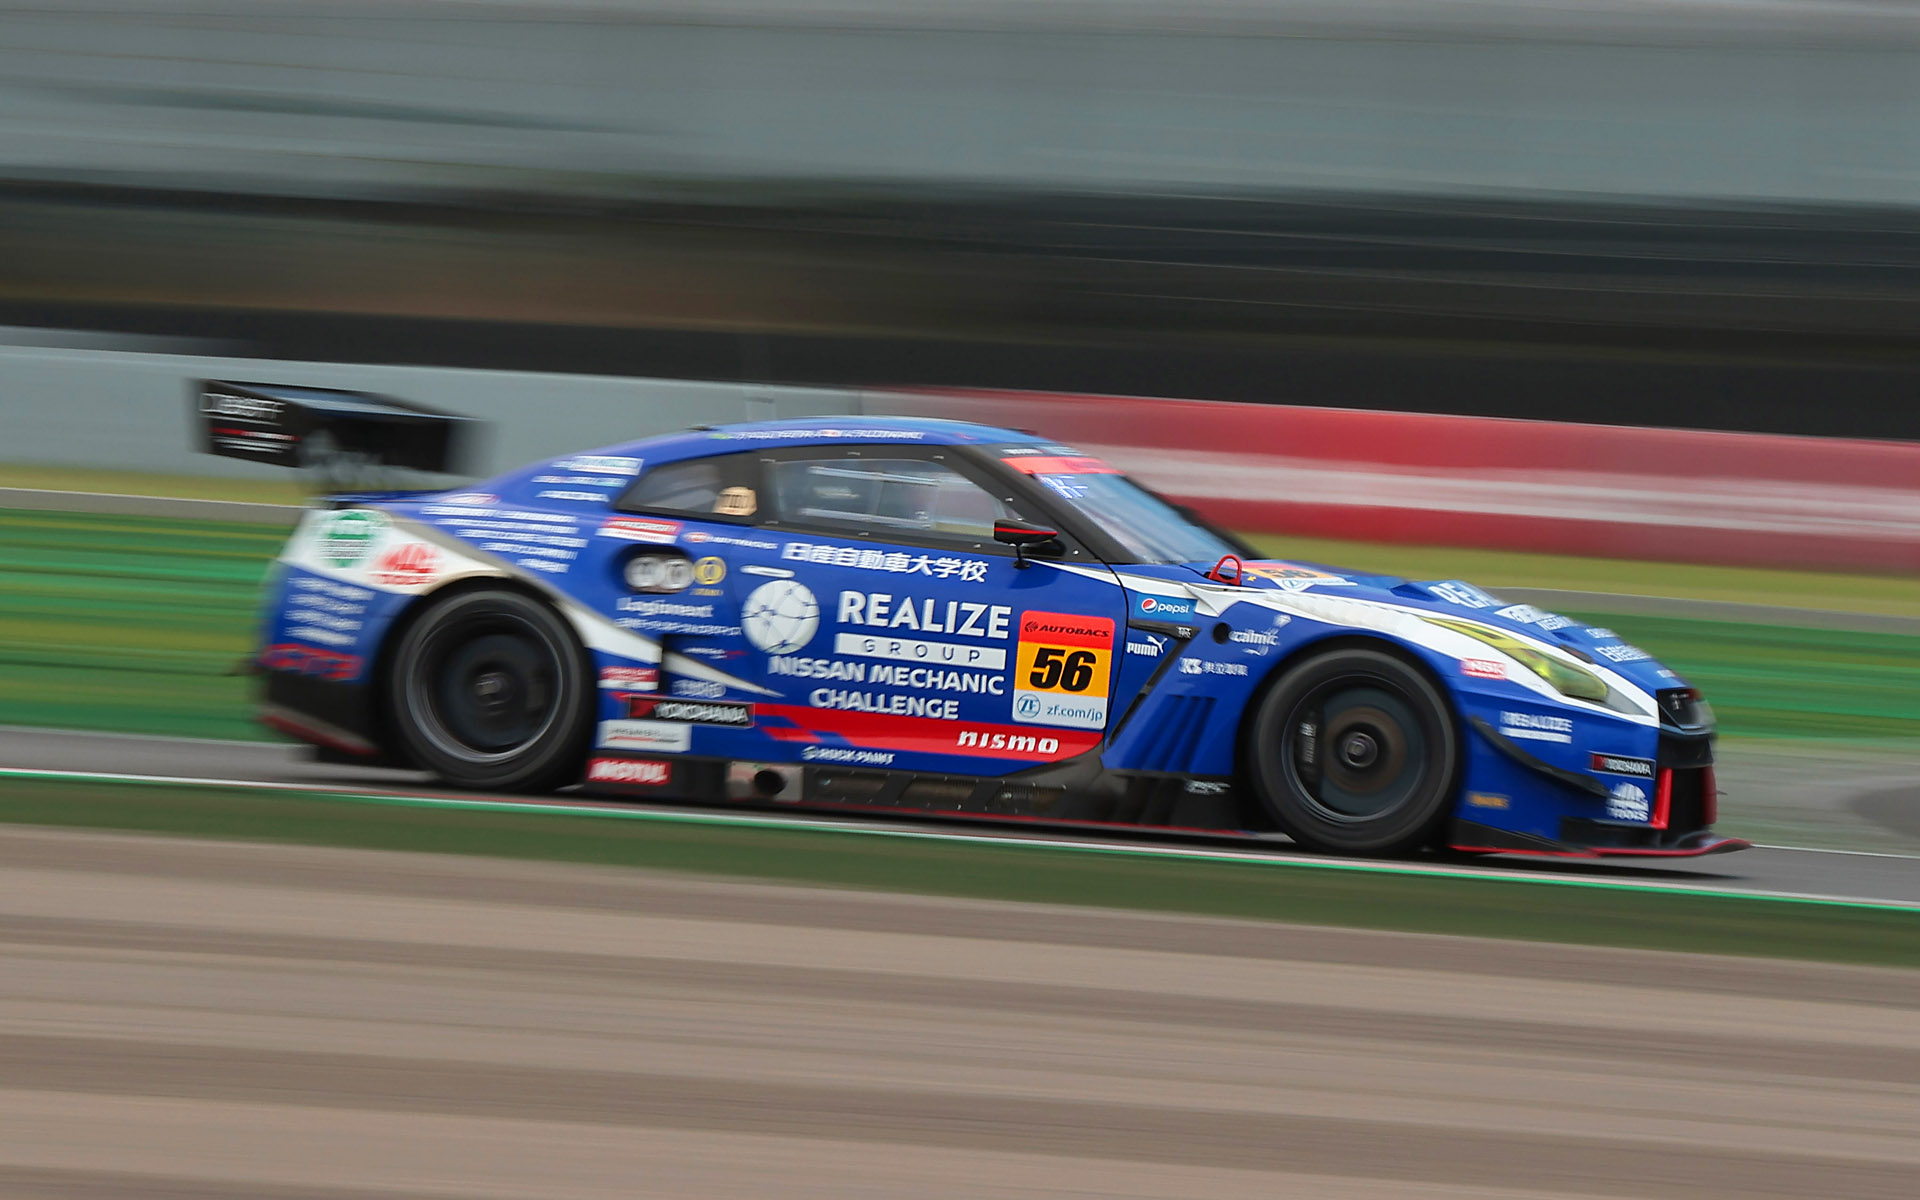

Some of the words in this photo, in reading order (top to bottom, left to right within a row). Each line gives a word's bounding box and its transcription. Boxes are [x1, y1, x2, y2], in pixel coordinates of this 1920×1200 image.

[782, 542, 989, 583] 日産自動車大学校
[837, 590, 1012, 640] REALIZE
[1157, 603, 1190, 614] pepsi
[1039, 625, 1110, 638] AUTOBACS
[863, 639, 981, 664] GROUP
[768, 655, 866, 682] NISSAN
[868, 664, 1005, 696] MECHANIC
[1029, 647, 1097, 692] 56
[654, 702, 749, 724] YOKOHAMA
[809, 688, 959, 720] CHALLENGE
[1047, 704, 1103, 722] zf.com/jp
[957, 730, 1060, 754] nismo
[588, 760, 668, 783] MOTUL
